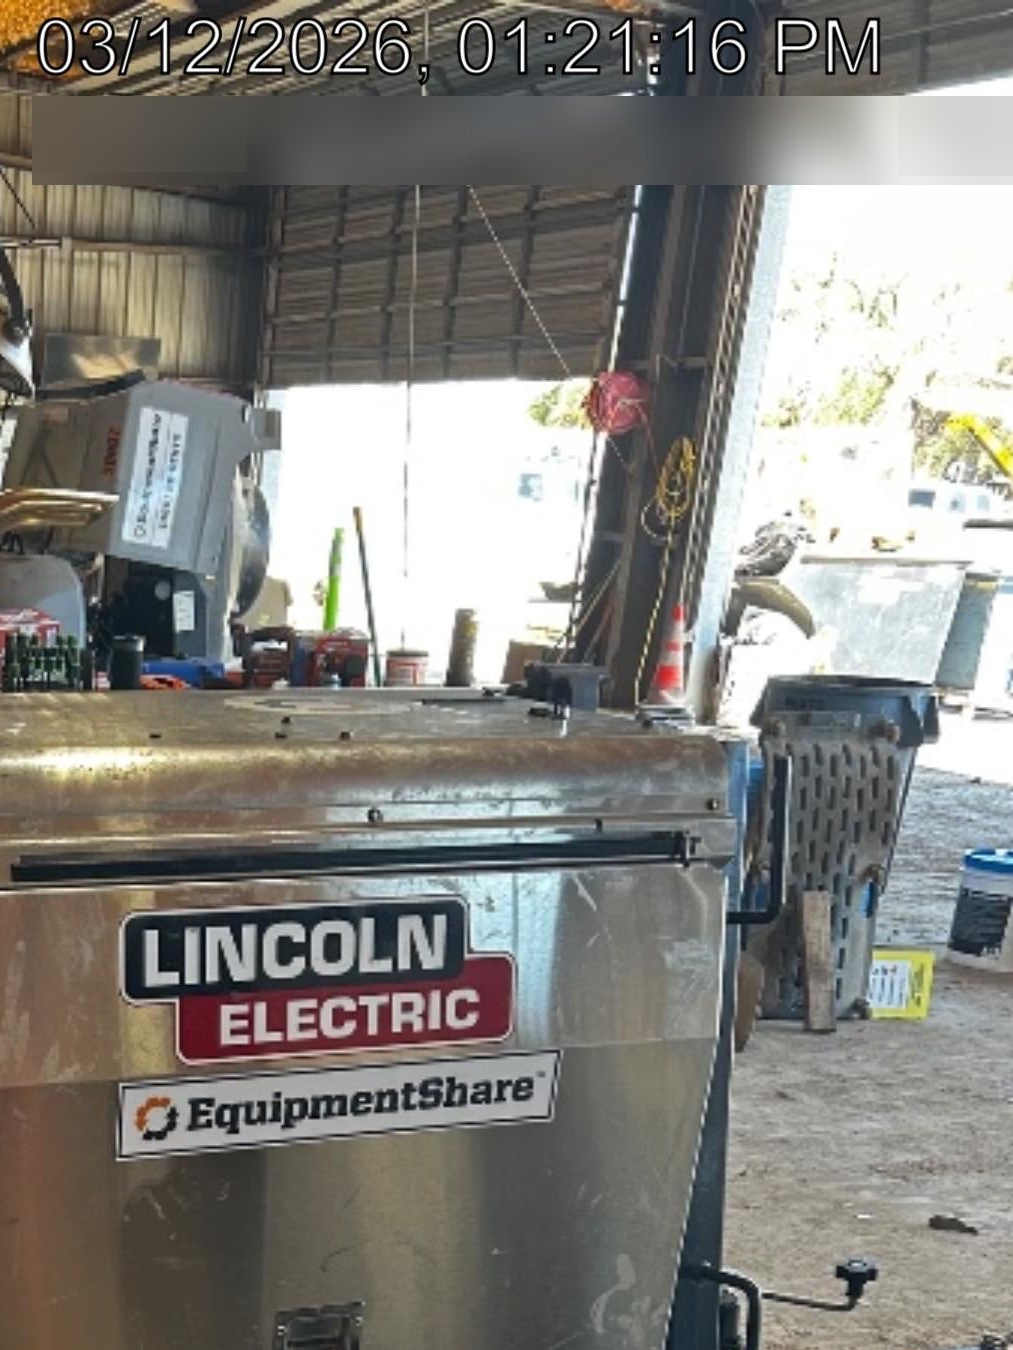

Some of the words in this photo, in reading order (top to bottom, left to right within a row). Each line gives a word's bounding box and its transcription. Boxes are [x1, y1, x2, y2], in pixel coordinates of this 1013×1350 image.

[143, 914, 447, 988] LINCOLN
[219, 988, 481, 1046] ELECTRIC
[185, 1076, 536, 1135] EquipmentShare
